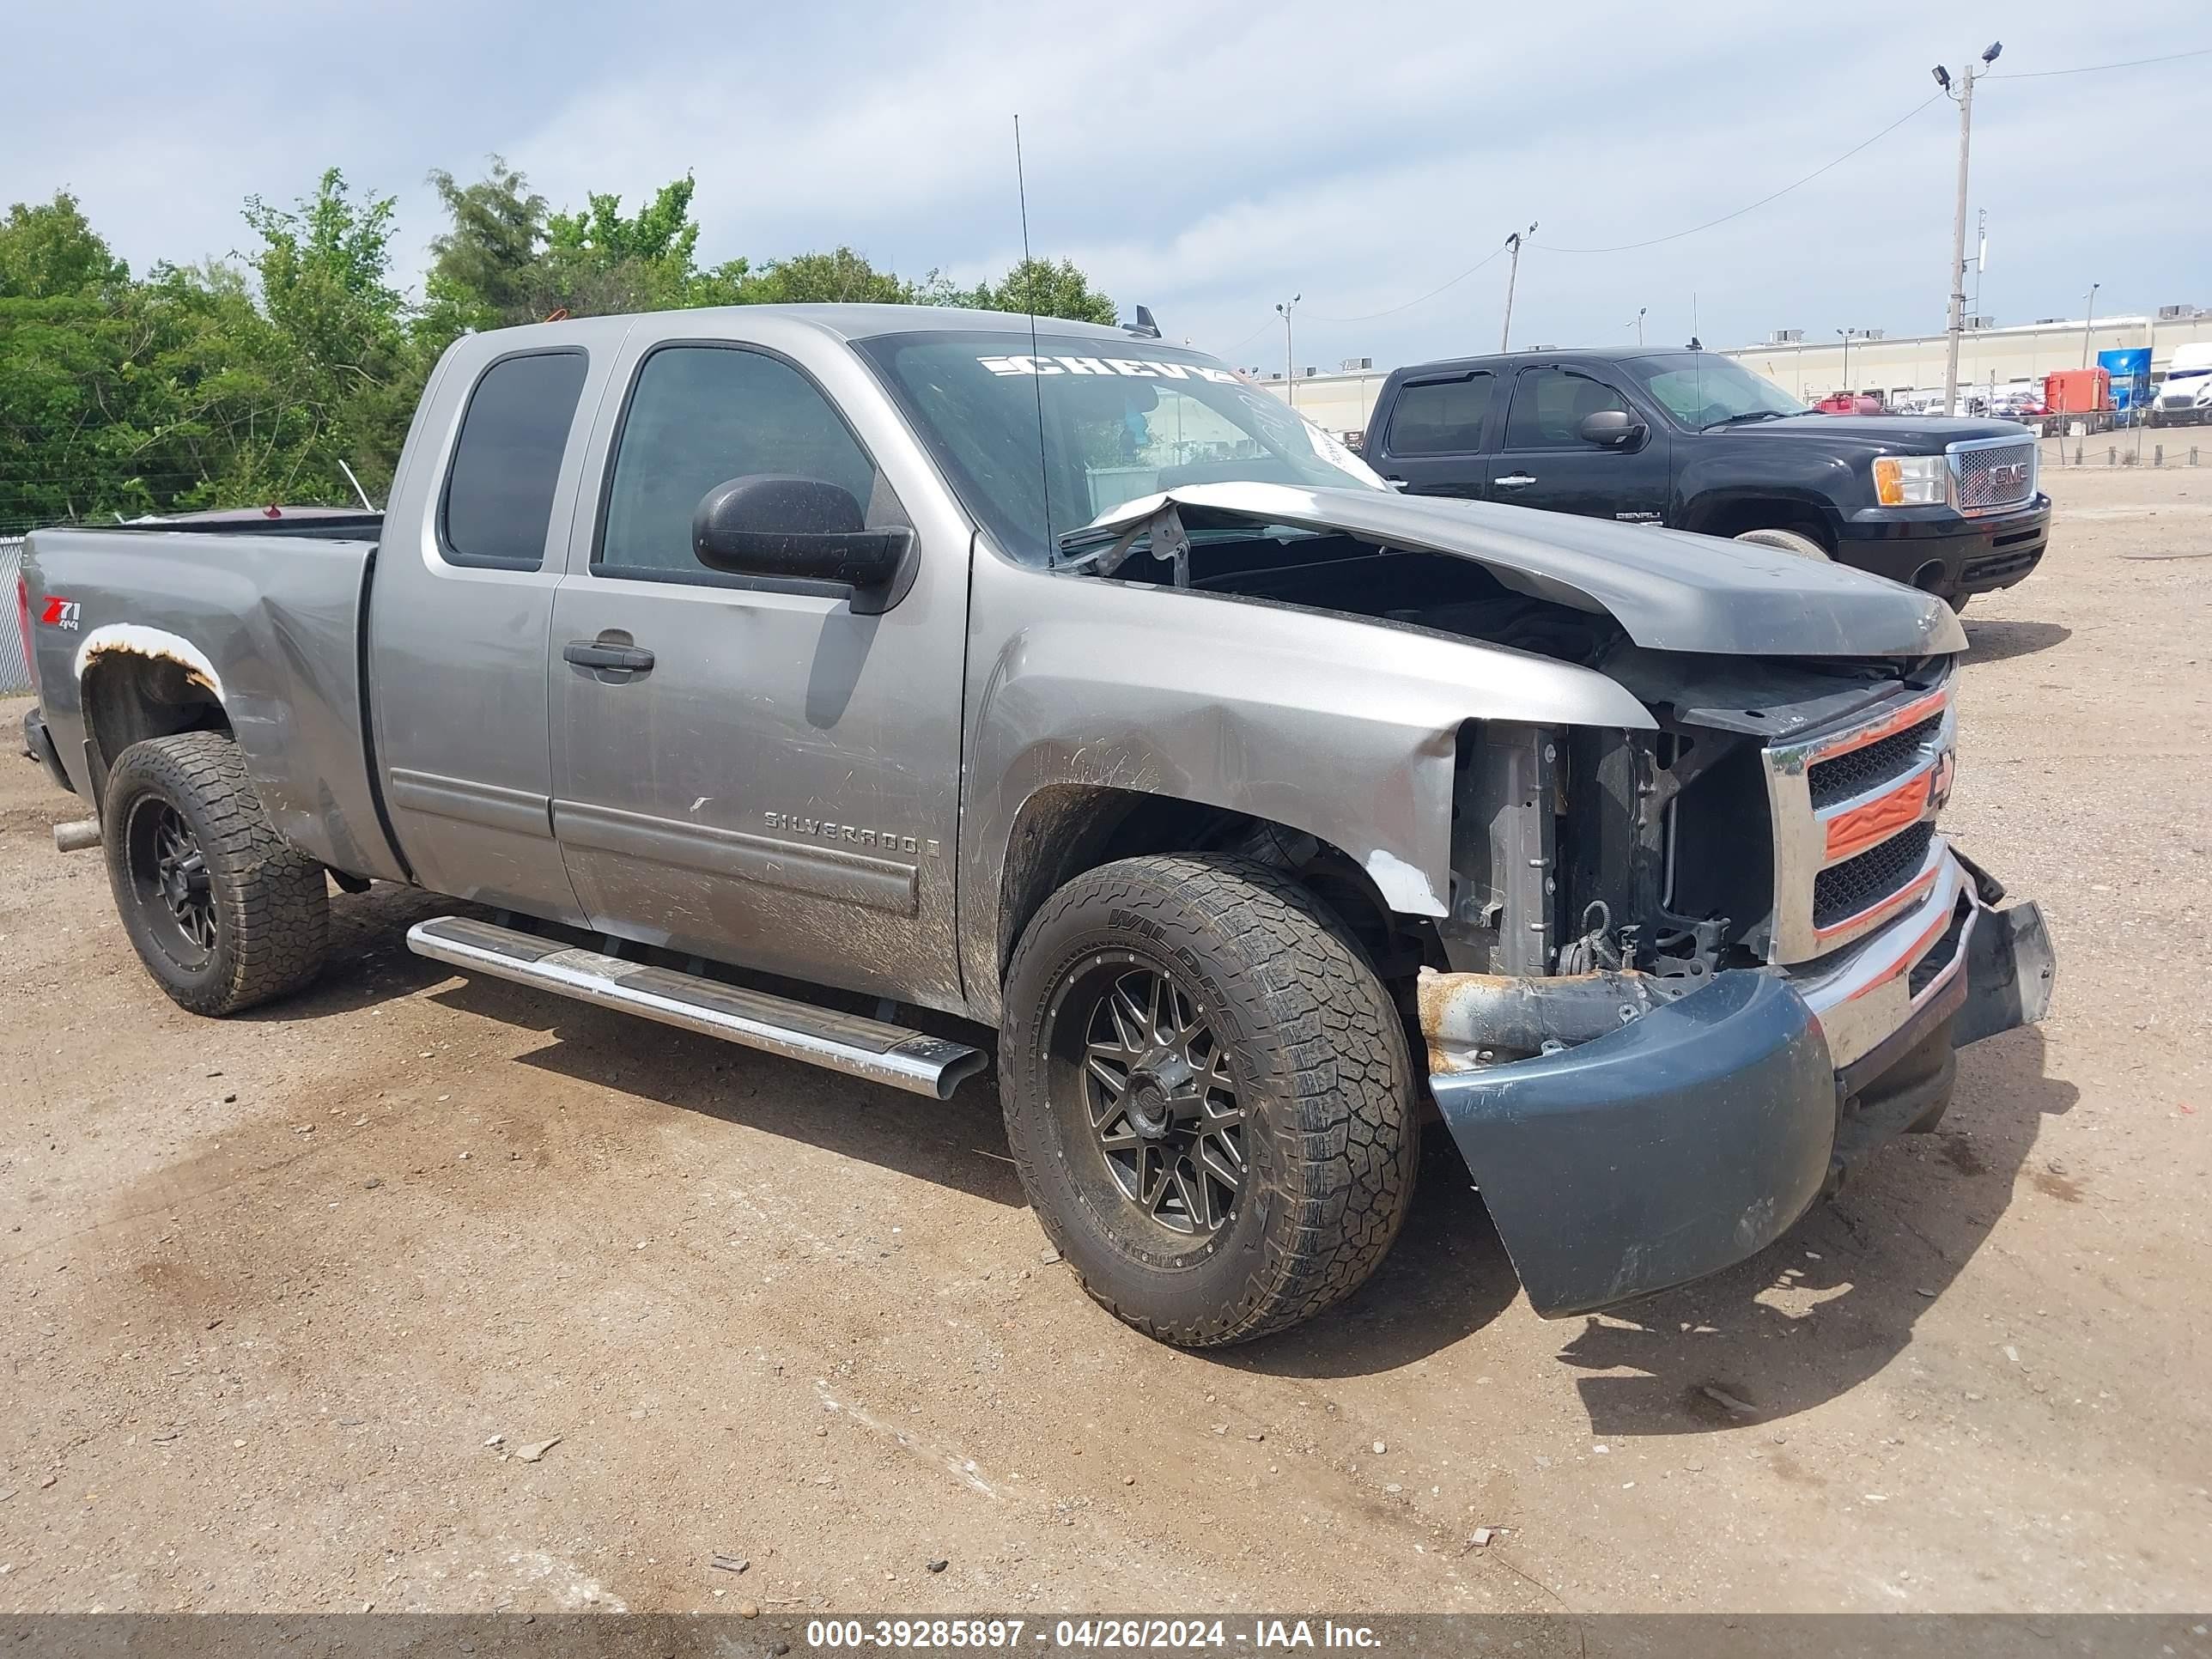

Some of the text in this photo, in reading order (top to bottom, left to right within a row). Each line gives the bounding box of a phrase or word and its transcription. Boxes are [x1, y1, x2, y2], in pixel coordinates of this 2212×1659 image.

[1006, 355, 1243, 386] CHEVY
[1990, 463, 2028, 484] GMC
[1615, 511, 1661, 520] DENALI
[40, 596, 82, 623] Z71
[764, 811, 917, 854] SILVERADO
[1107, 908, 1270, 1127] WILDPEAK
